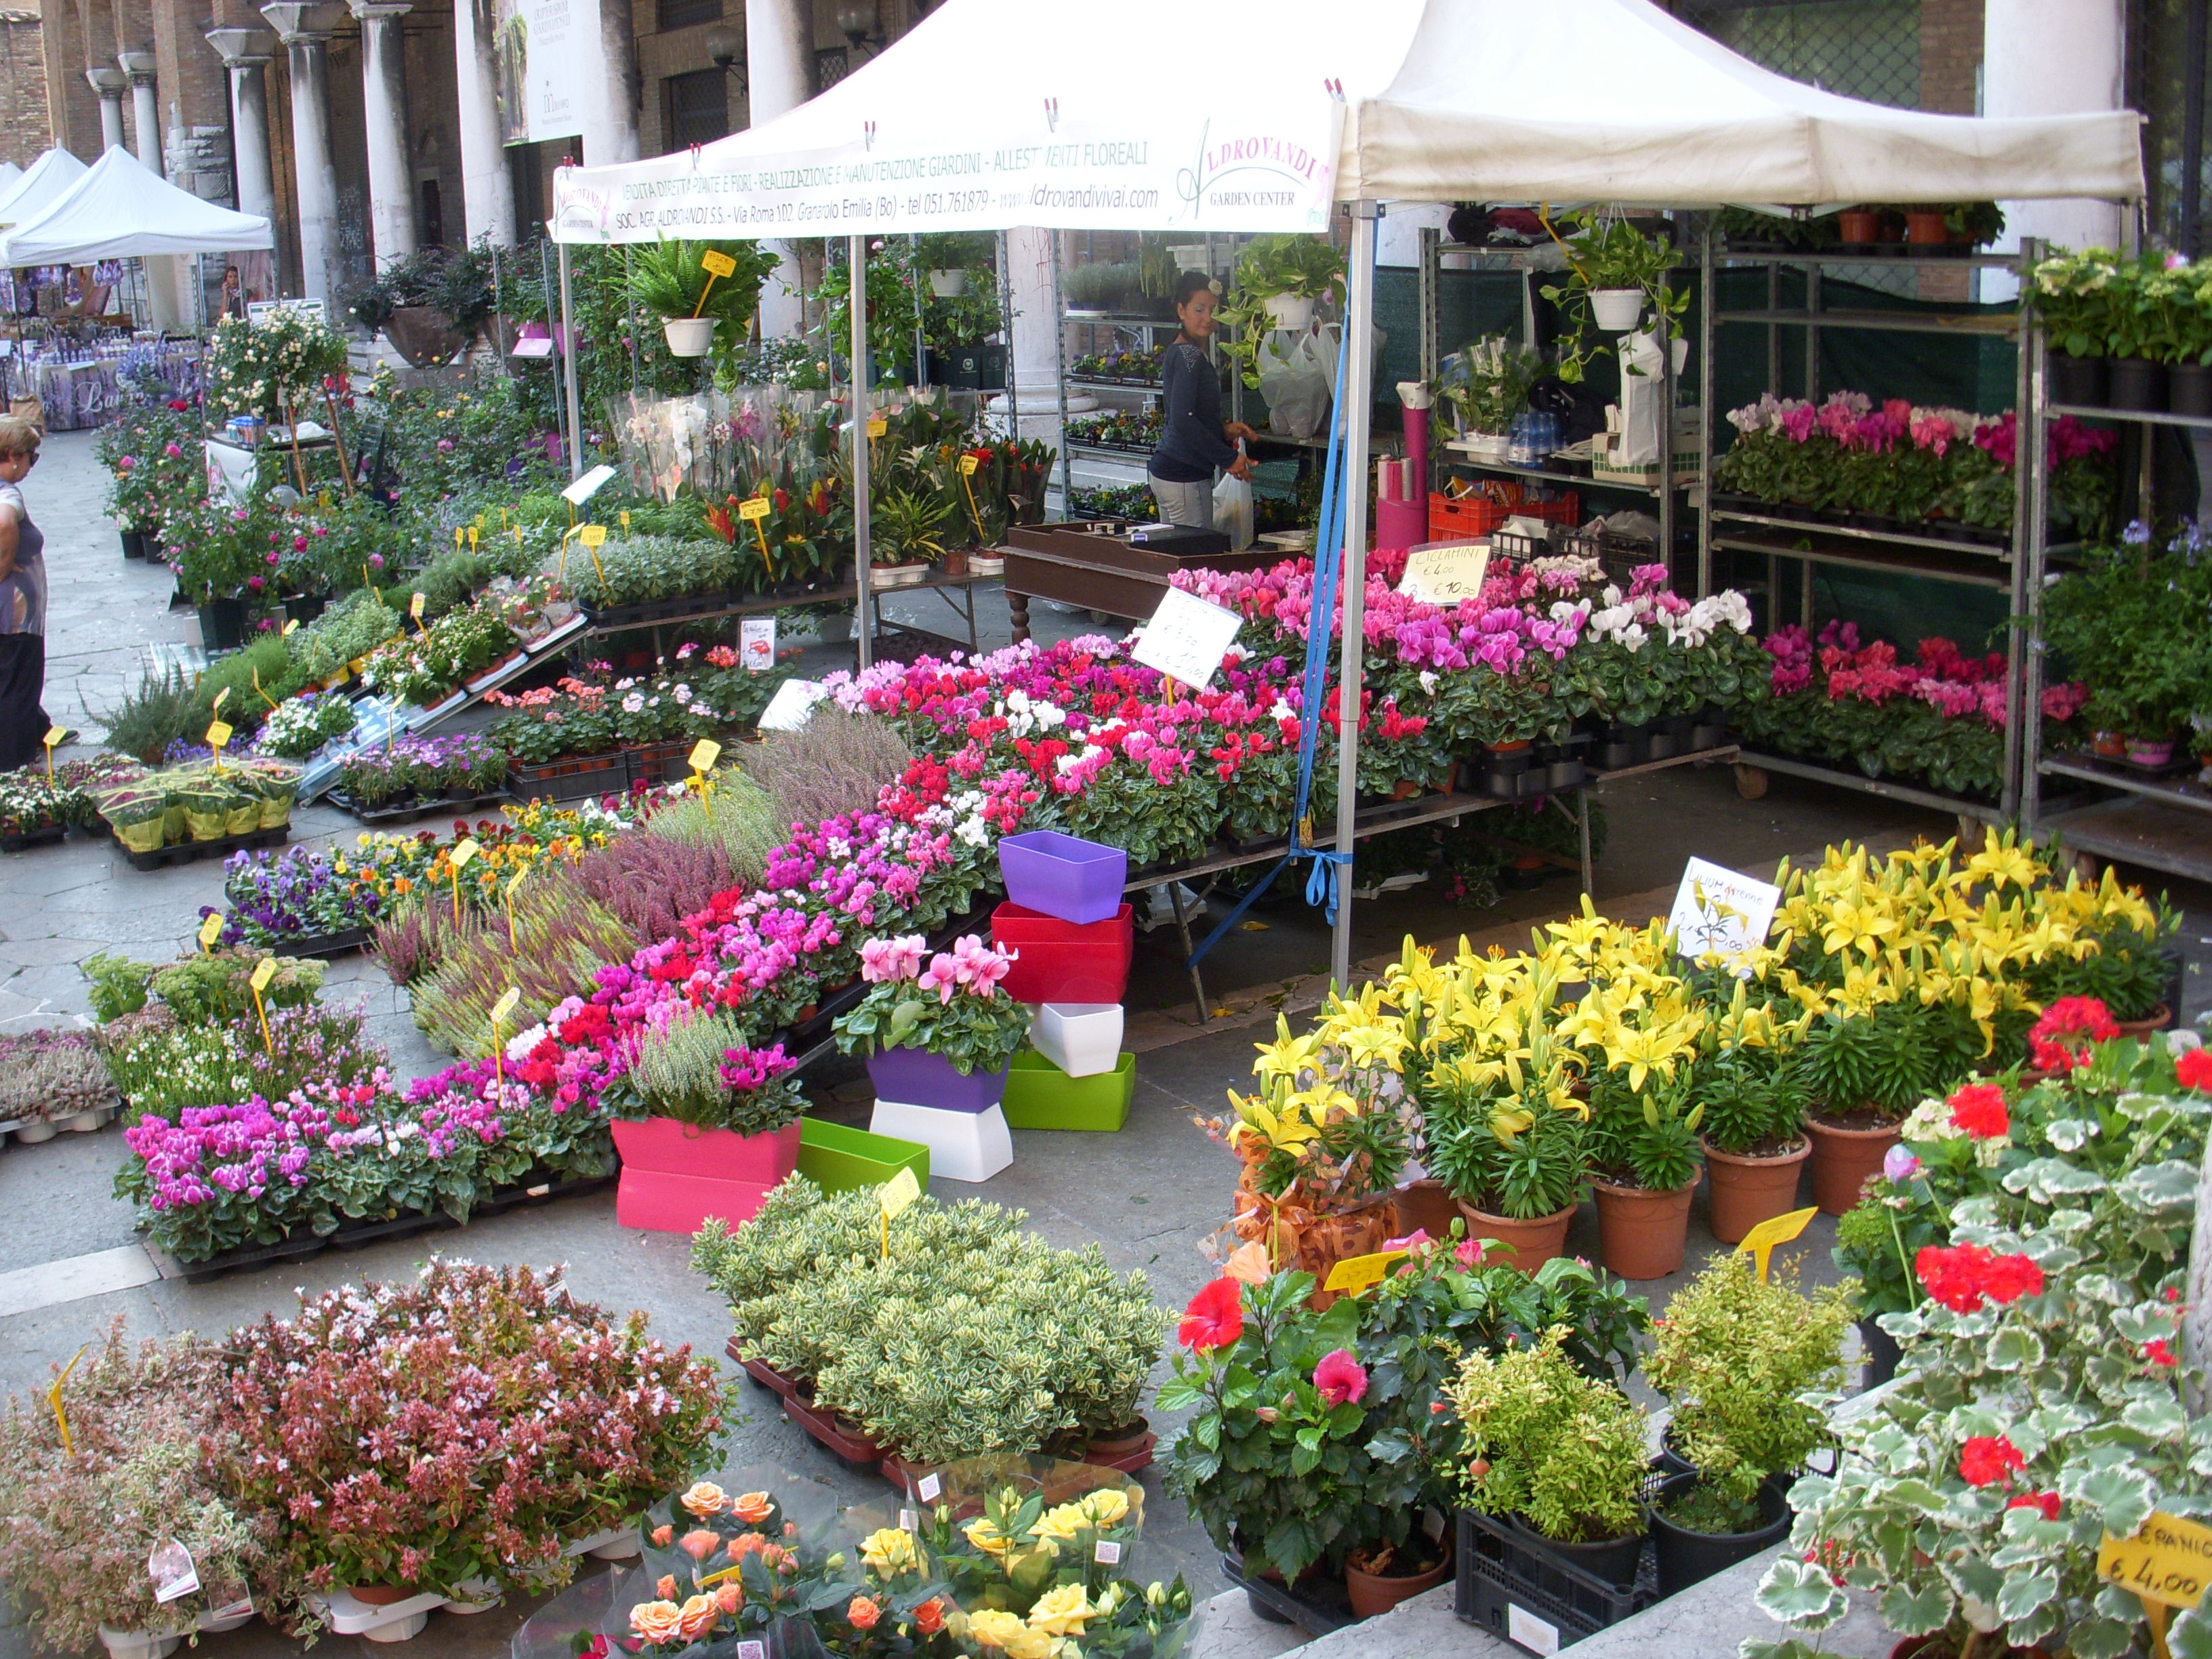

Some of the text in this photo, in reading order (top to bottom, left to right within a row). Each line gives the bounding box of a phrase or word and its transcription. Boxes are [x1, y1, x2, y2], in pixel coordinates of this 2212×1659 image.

[722, 176, 729, 193] E
[731, 173, 753, 192] FIORI
[758, 166, 833, 190] REALIZZAZIONE
[835, 165, 842, 184] E
[928, 152, 981, 178] GIARDINI
[1084, 141, 1149, 167] FLOREALI
[1210, 190, 1295, 206] GARDEN CENTER
[616, 212, 637, 229] SOC.
[710, 206, 725, 224] S.S.
[733, 205, 747, 224] Via
[750, 205, 774, 224] Roma
[798, 199, 838, 222] Granarolo
[842, 197, 872, 218] Emilia
[875, 195, 897, 221] (Bo)
[908, 194, 921, 215] tel
[924, 190, 989, 215] 051.761879
[1416, 547, 1479, 565] CICLAMINI
[1423, 566, 1431, 575] €
[1433, 583, 1443, 596] €
[2138, 1524, 2212, 1558] ERANIO
[2109, 1557, 2125, 1581] €
